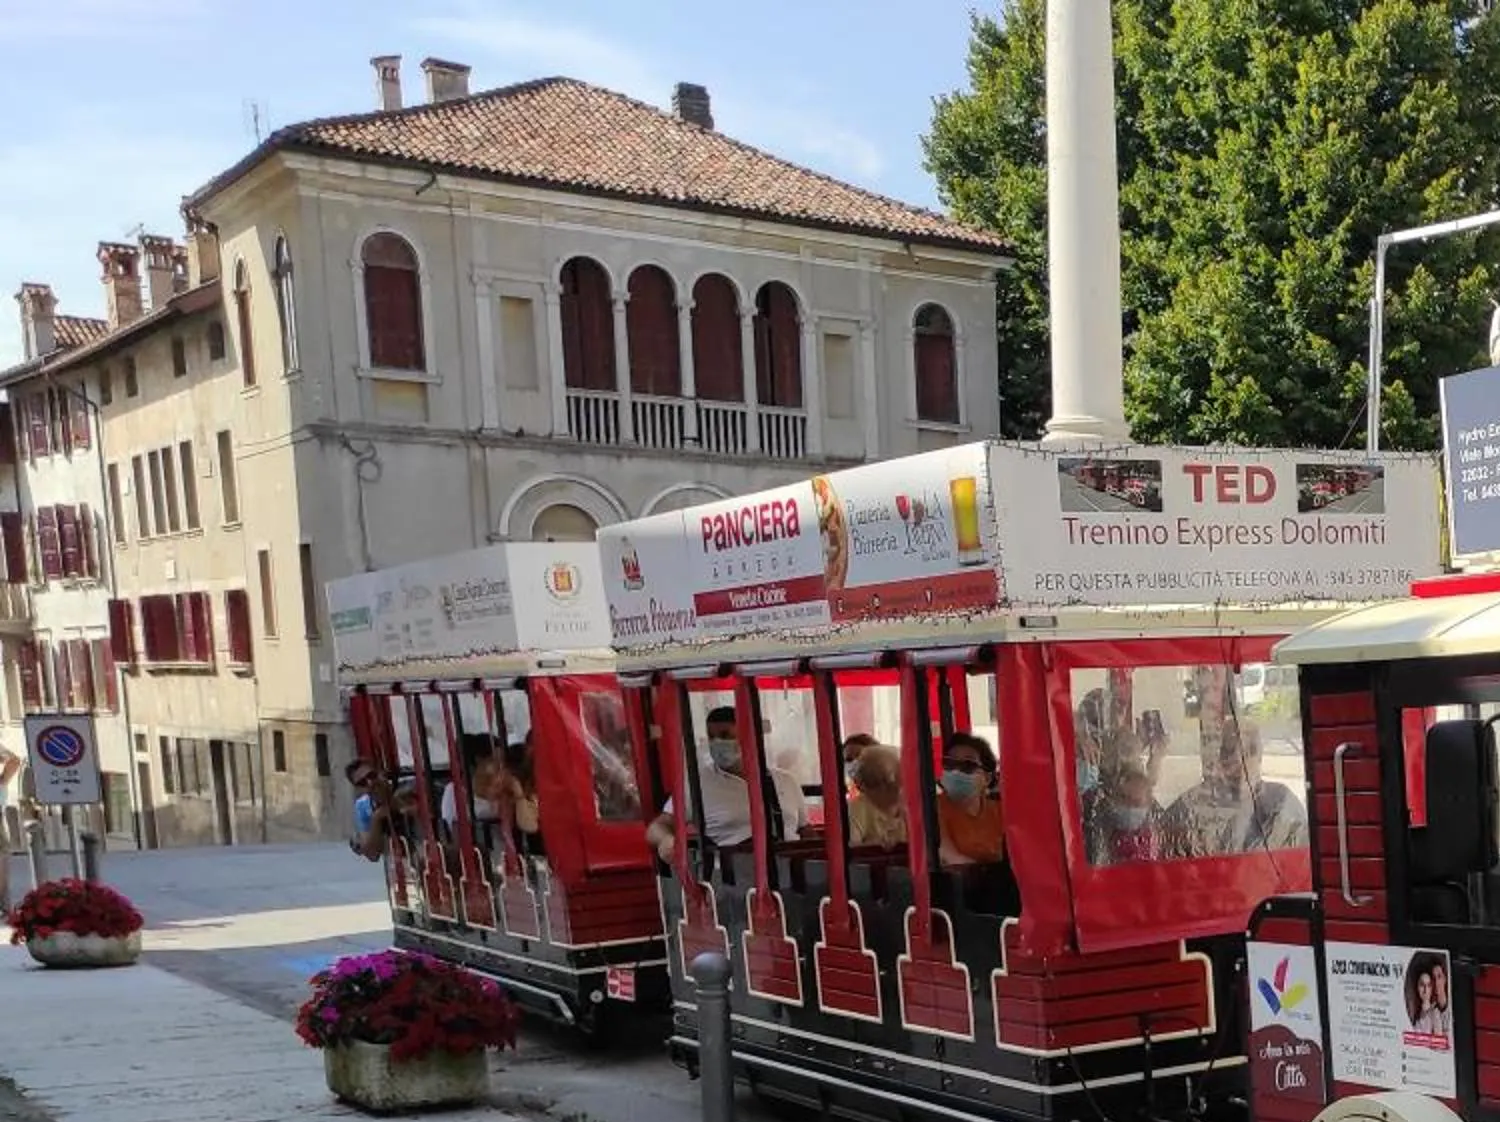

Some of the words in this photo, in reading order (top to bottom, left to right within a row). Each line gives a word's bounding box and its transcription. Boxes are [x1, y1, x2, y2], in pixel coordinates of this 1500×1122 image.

[1182, 464, 1277, 504] TED
[1062, 517, 1168, 546] Trenino
[1177, 518, 1273, 551] Express
[1282, 516, 1386, 546] Dolomiti
[1035, 573, 1065, 590] PER
[1069, 573, 1133, 592] QUESTA
[1226, 570, 1301, 587] TELEFONA
